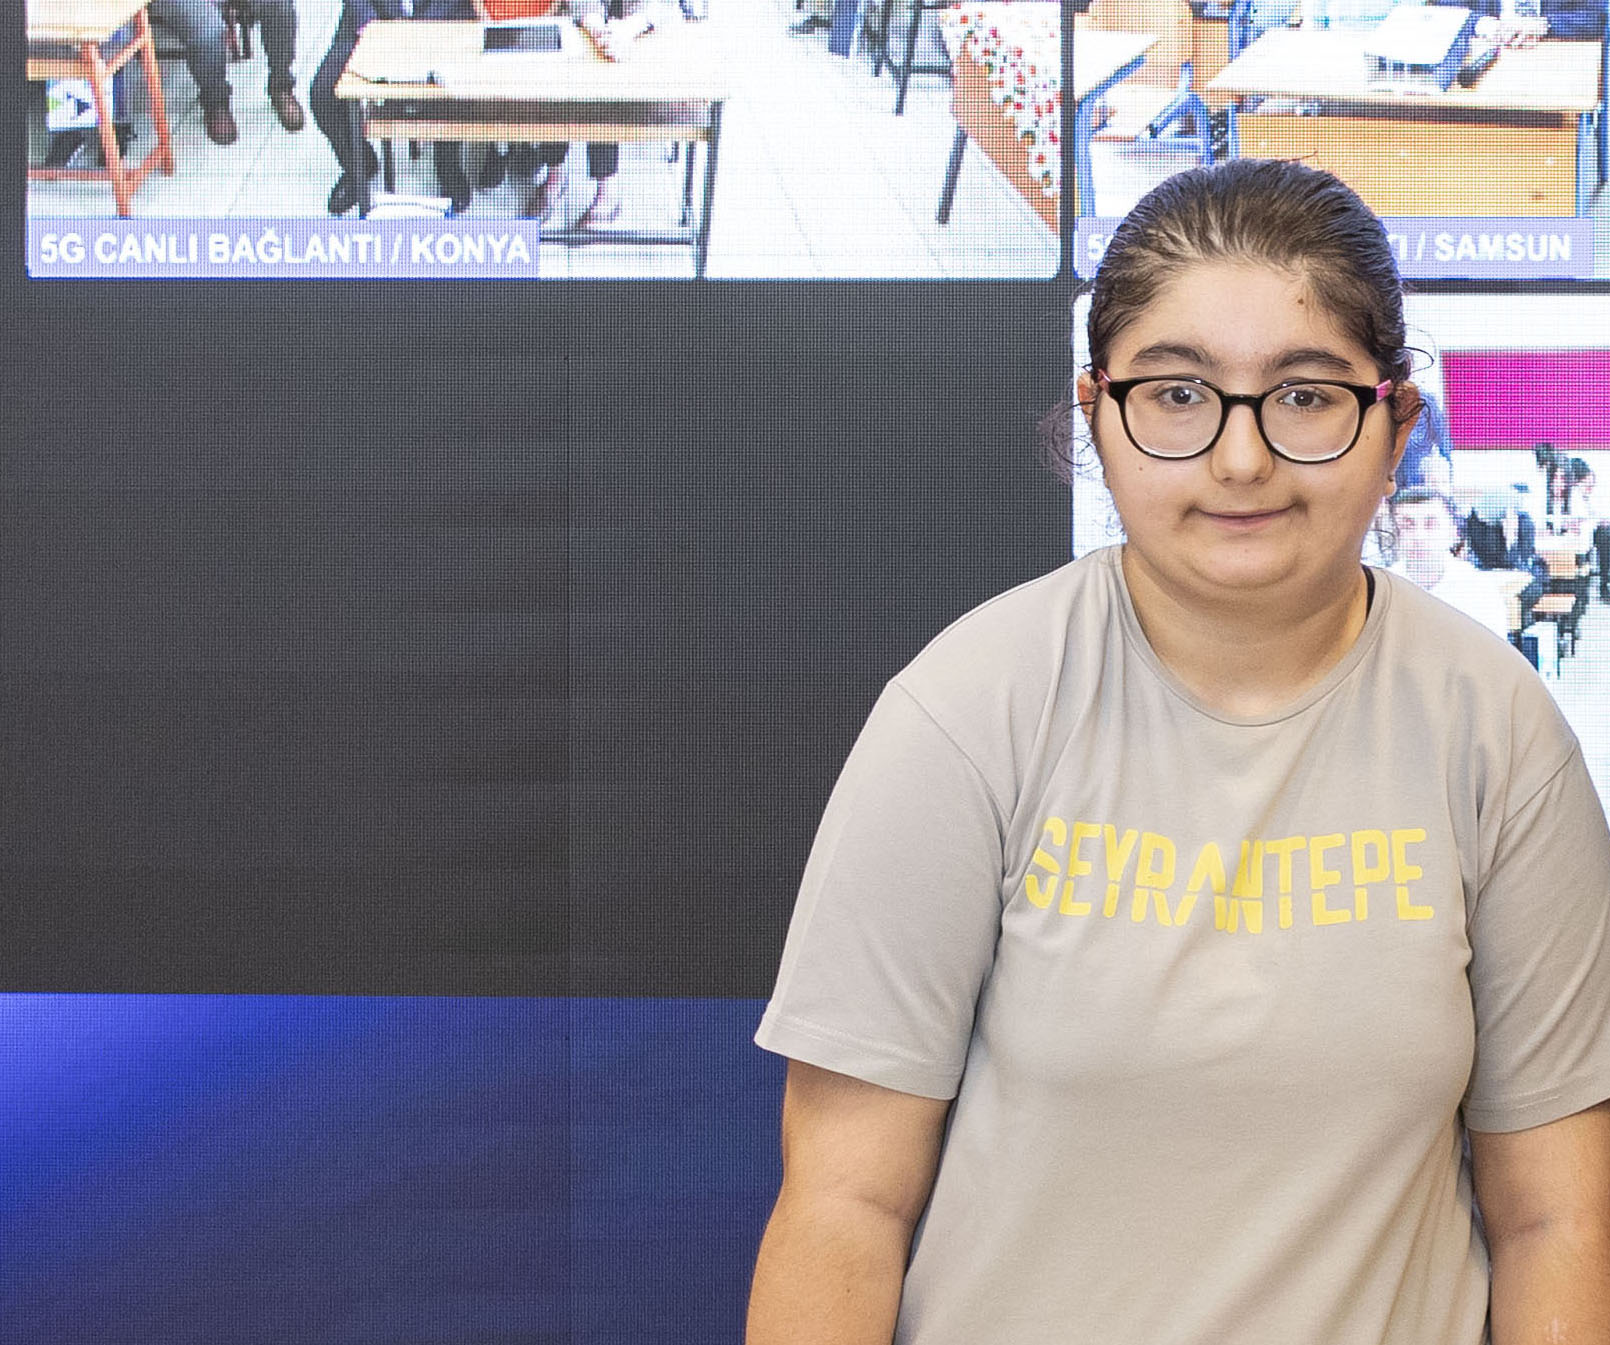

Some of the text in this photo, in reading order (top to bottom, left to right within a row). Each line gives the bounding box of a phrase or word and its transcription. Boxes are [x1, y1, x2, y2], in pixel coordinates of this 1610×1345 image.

[40, 233, 86, 264] 5G
[94, 233, 198, 264] CANLI
[208, 228, 383, 264] BAĞLANTI
[411, 233, 532, 264] KONYA
[1435, 232, 1571, 262] SAMSUN
[1025, 816, 1435, 935] SEYRANTEPE
